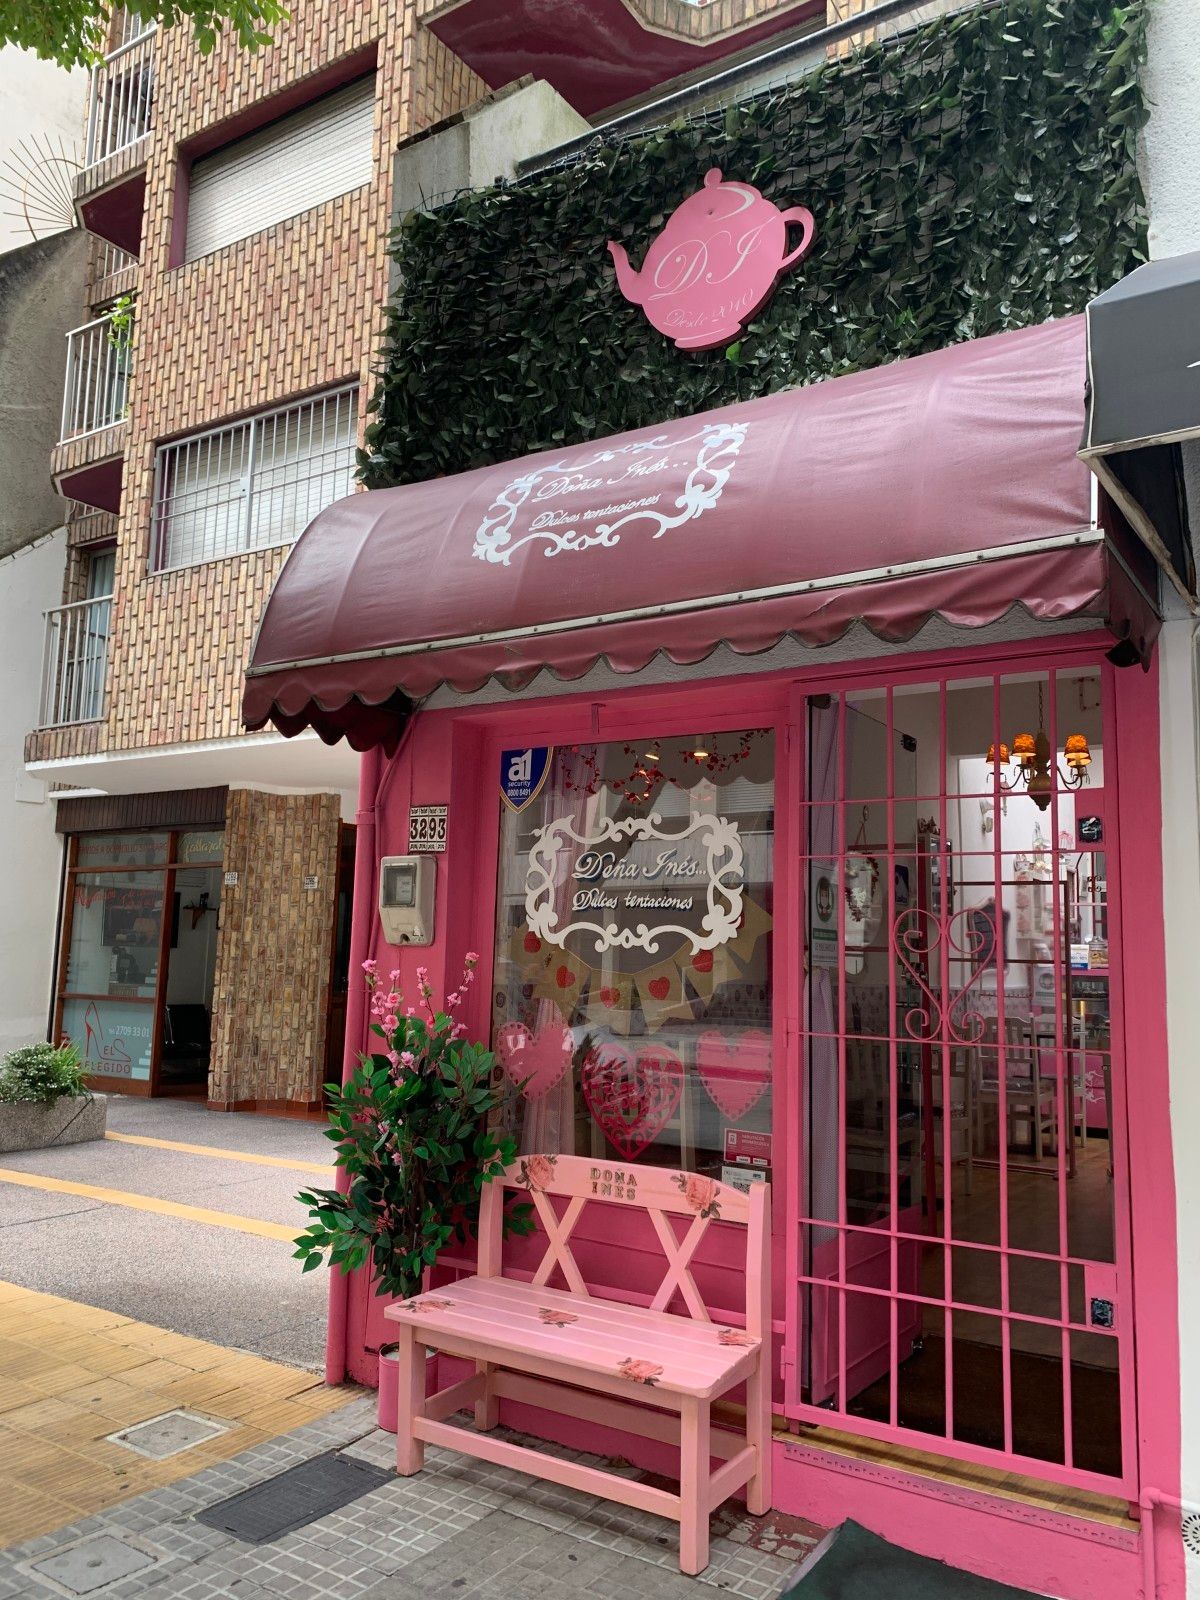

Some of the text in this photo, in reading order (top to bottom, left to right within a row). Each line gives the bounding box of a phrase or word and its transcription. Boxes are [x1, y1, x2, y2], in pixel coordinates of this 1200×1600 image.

[531, 474, 603, 503] Doña
[528, 493, 661, 532] Dulces tentaciones
[410, 817, 446, 840] 3293
[571, 851, 640, 879] Doña
[572, 887, 693, 911] Dulces tentaciones
